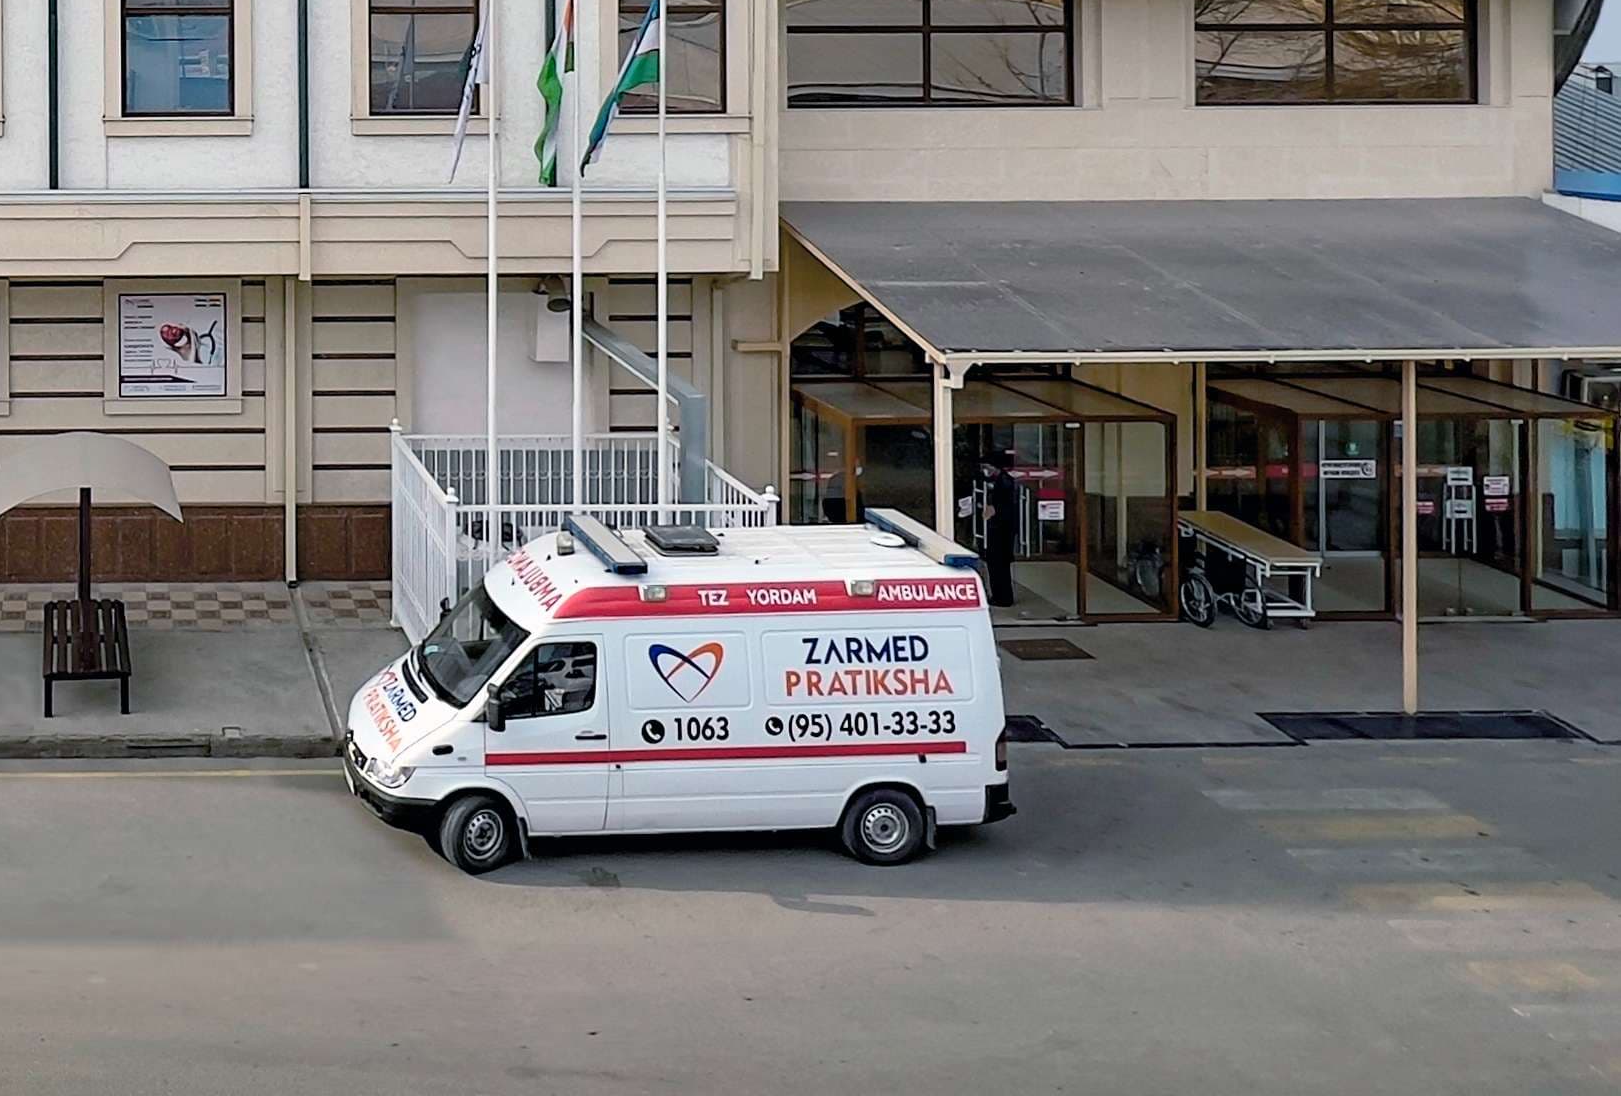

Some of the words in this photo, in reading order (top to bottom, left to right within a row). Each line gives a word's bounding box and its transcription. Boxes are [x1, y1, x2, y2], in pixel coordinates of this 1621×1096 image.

[698, 589, 729, 606] TEZ
[746, 588, 817, 605] YORDAM
[878, 583, 977, 602] AMBULANCE
[802, 635, 929, 665] ZARMED
[785, 668, 955, 697] PRATIKSHA
[674, 717, 730, 742] 1063
[788, 713, 832, 742] (95)
[840, 710, 956, 737] 401-33-33
